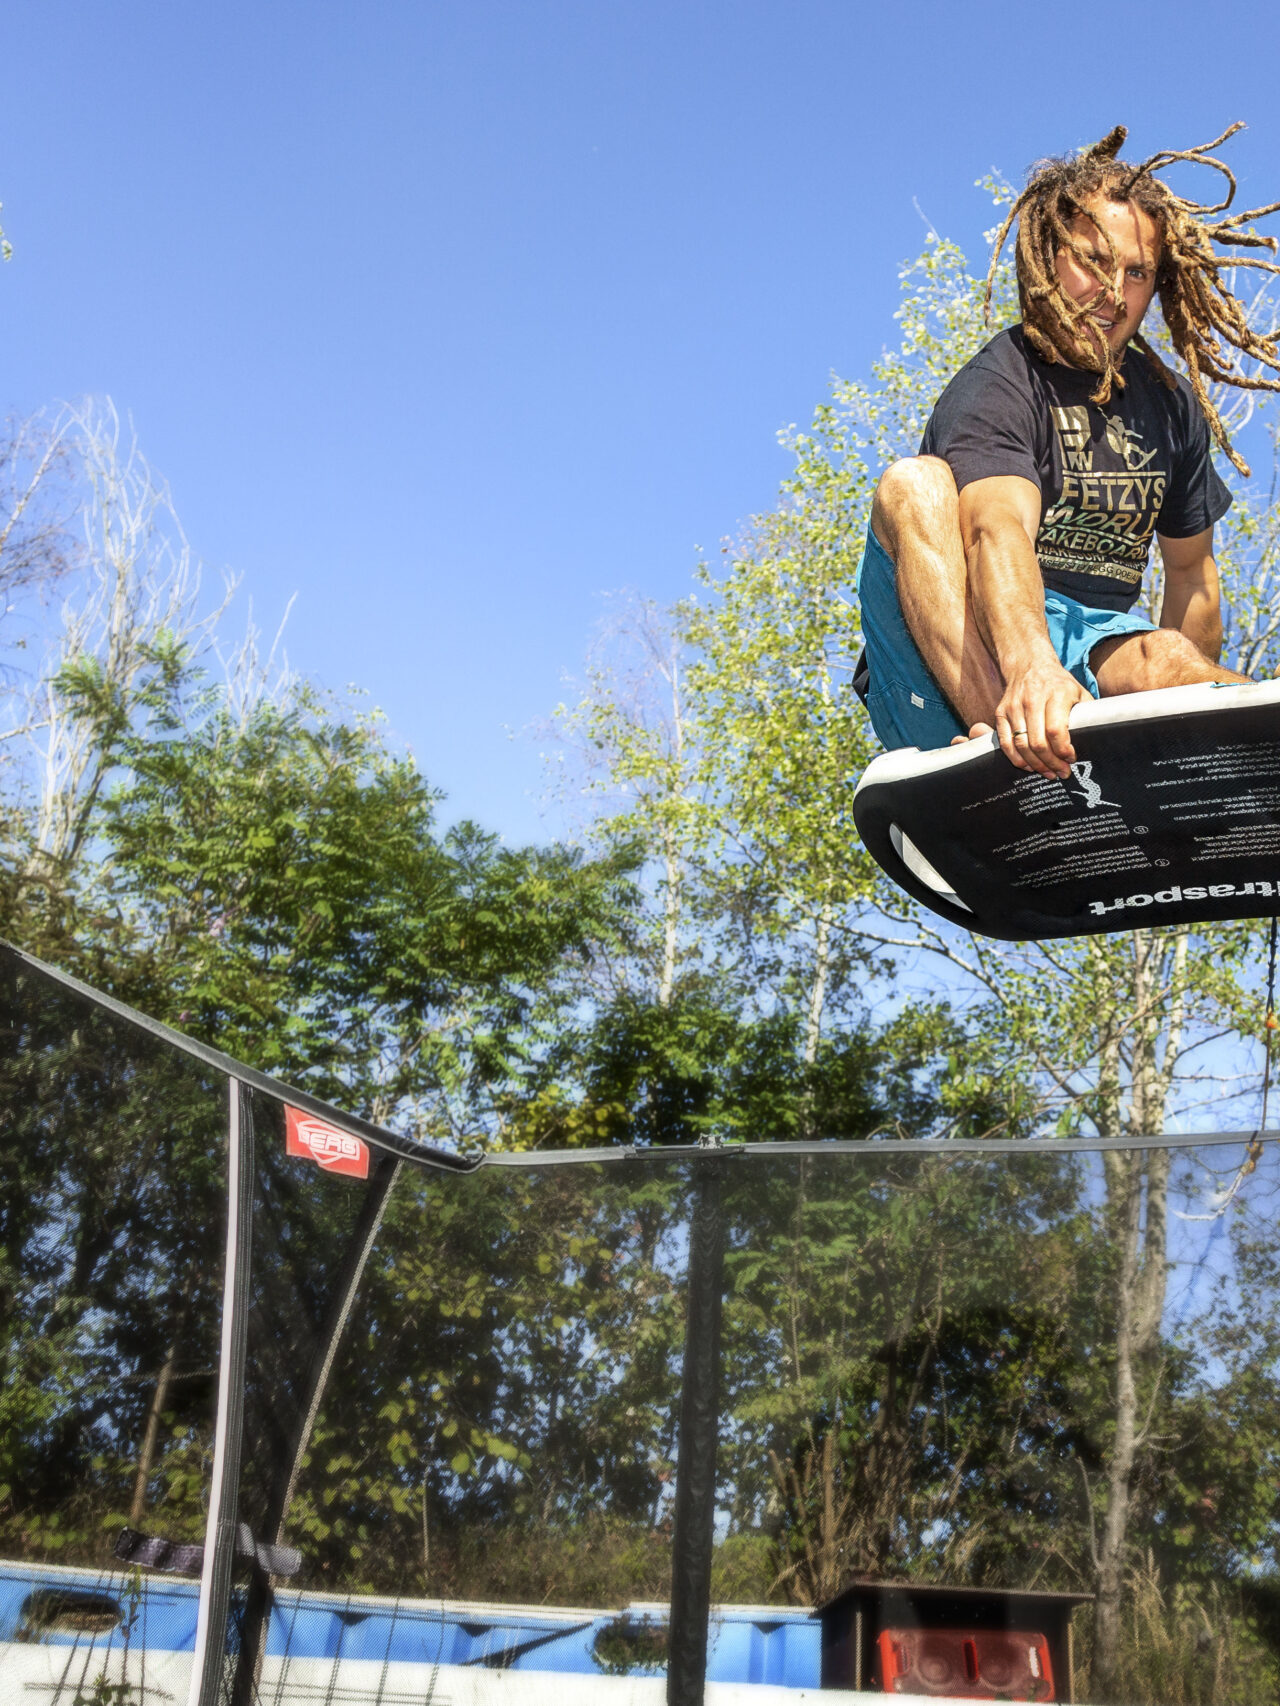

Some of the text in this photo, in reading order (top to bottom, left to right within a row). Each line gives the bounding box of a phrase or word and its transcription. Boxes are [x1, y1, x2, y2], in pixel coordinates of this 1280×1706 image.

[1055, 477, 1166, 512] FETZYS
[1038, 527, 1148, 560] AKEBOARD
[300, 1128, 358, 1156] BERG
